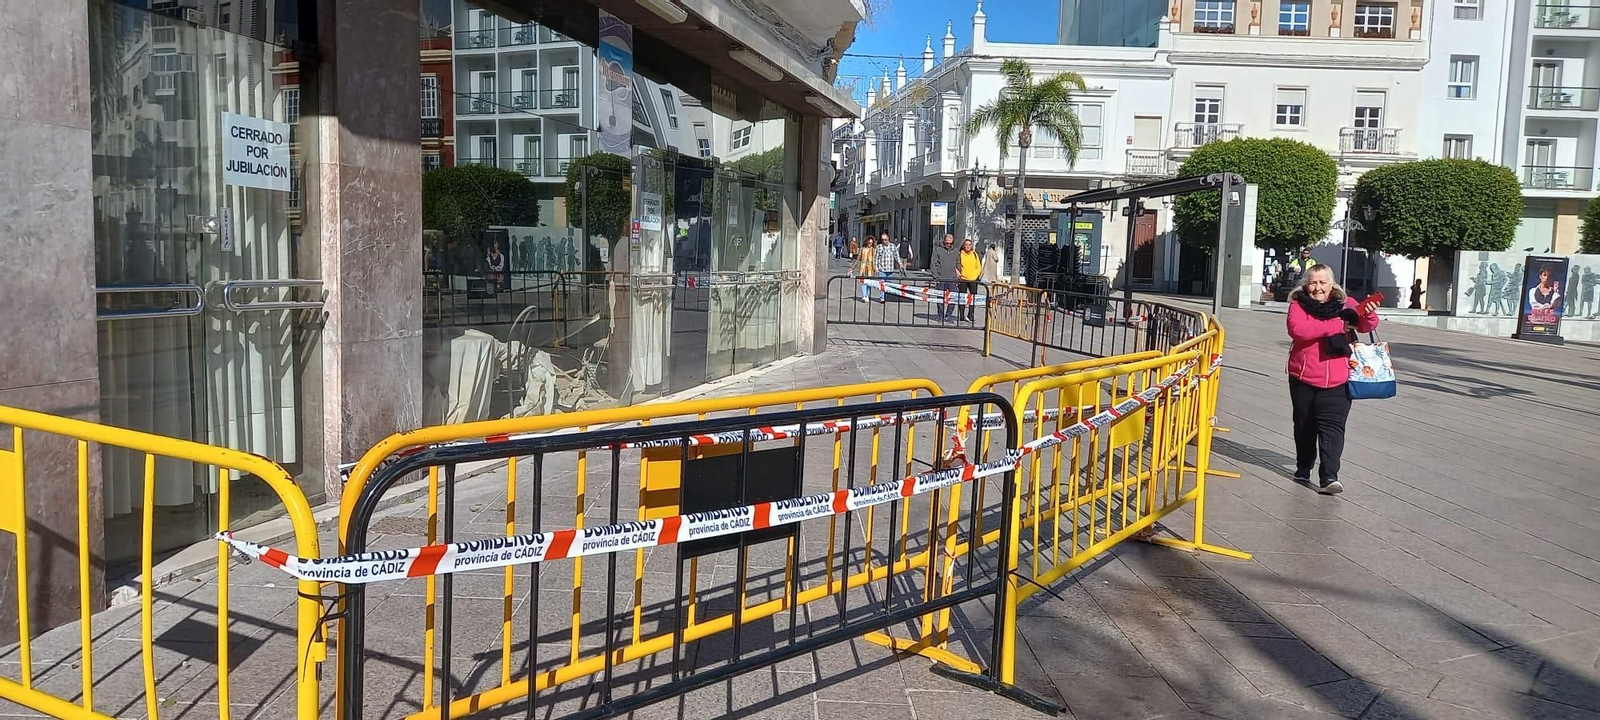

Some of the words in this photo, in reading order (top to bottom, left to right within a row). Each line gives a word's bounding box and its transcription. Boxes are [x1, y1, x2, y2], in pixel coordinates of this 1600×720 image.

[230, 125, 283, 145] CERRADO
[246, 145, 269, 160] POR
[226, 159, 288, 178] JUBILACIÓN
[805, 508, 813, 516] de
[813, 504, 832, 514] CÁDIZ
[688, 523, 719, 538] provincia
[721, 522, 729, 531] de
[730, 517, 751, 529] CÁDIZ
[582, 536, 618, 553] provincia
[620, 535, 630, 545] de
[631, 531, 656, 543] CÁDIZ
[454, 552, 498, 569] provincia
[501, 550, 512, 561] de
[514, 546, 544, 559] CÁDIZ
[355, 566, 368, 578] de
[371, 560, 406, 576] CÁDIZ
